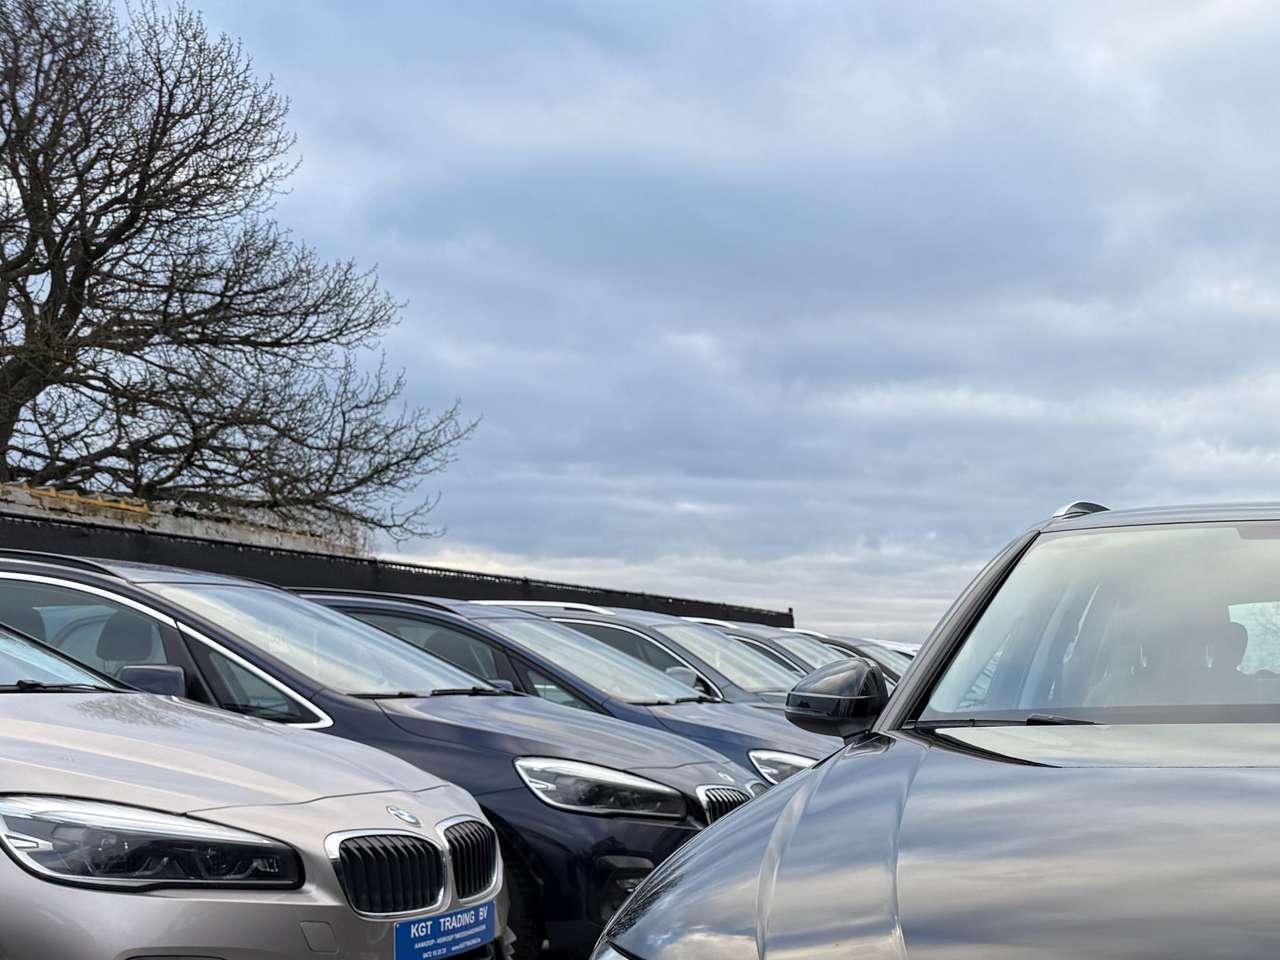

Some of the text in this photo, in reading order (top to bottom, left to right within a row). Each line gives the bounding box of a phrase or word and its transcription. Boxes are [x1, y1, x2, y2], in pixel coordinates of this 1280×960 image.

[411, 921, 433, 938] KGT
[439, 910, 475, 932] TRADING
[479, 905, 489, 921] BV
